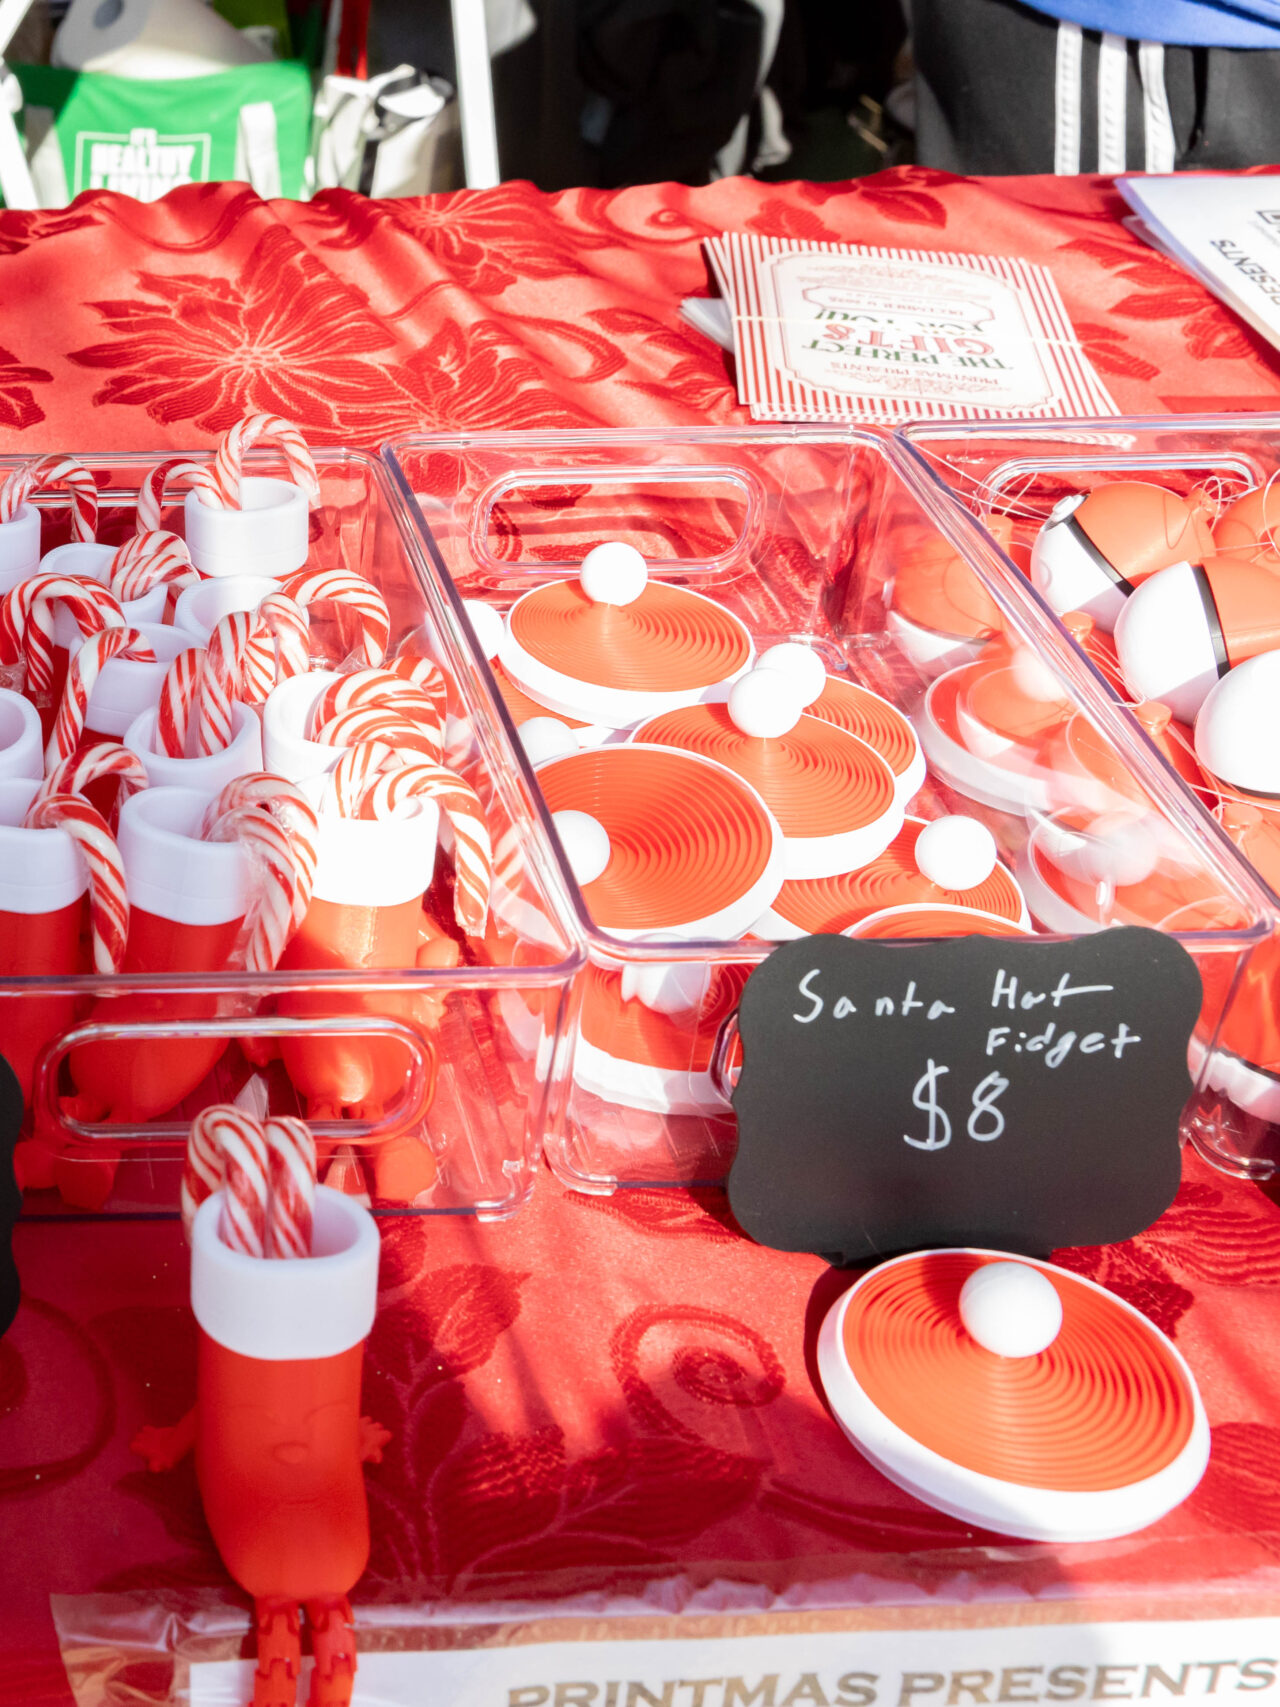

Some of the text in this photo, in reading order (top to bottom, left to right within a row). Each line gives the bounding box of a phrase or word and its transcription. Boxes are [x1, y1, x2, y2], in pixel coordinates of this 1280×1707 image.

[801, 339, 1014, 370] THE PERFECT
[822, 323, 995, 356] GIFTS
[830, 361, 999, 385] PRINTMAS PRESENTS
[793, 968, 1114, 1023] Santa Hat
[985, 1022, 1142, 1069] Fidget
[903, 1058, 1010, 1152] $8
[507, 1657, 1279, 1707] PRINTMAS PRESENTS
